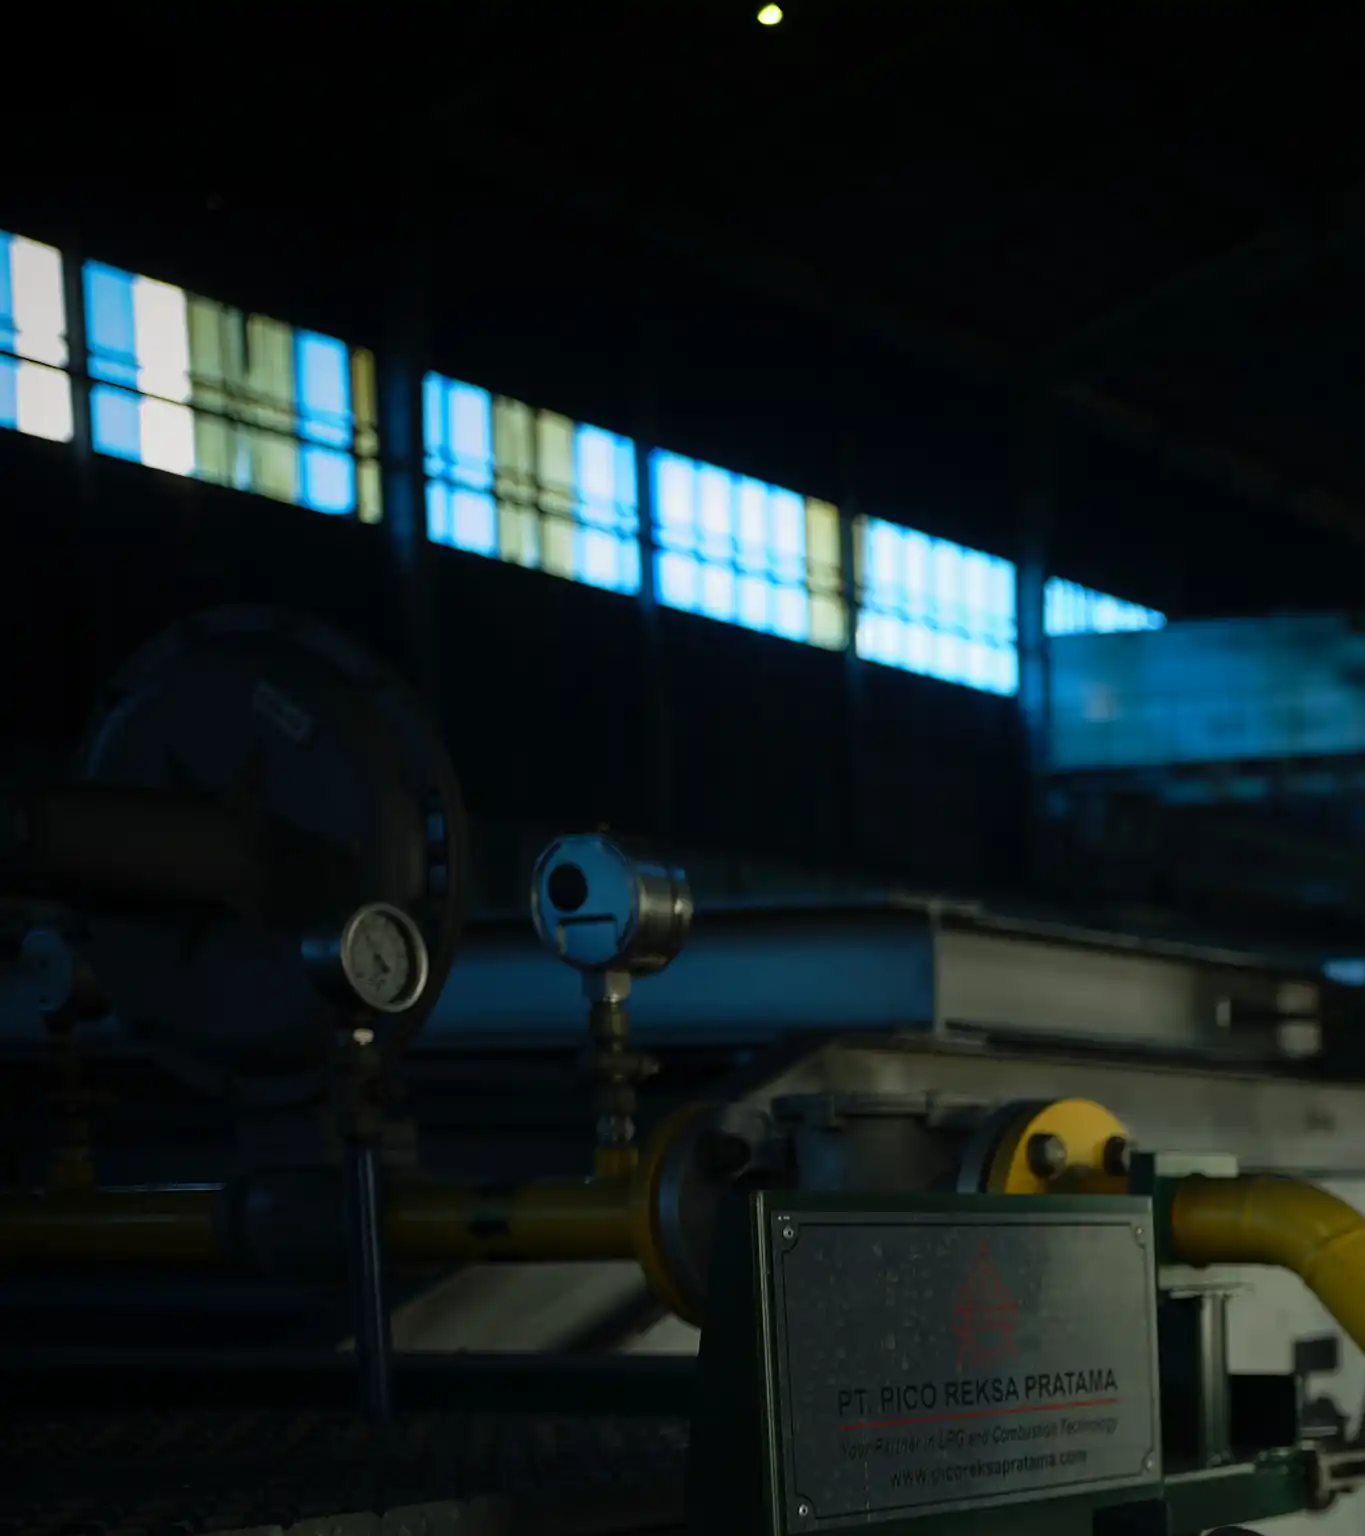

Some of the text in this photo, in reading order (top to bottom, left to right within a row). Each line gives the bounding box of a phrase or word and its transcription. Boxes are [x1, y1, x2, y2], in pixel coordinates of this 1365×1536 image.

[838, 1367, 1119, 1417] PT. PICO REKSA PRATAMA
[968, 1429, 988, 1446] and
[889, 1449, 1089, 1489] www.picoreksapratama.com
